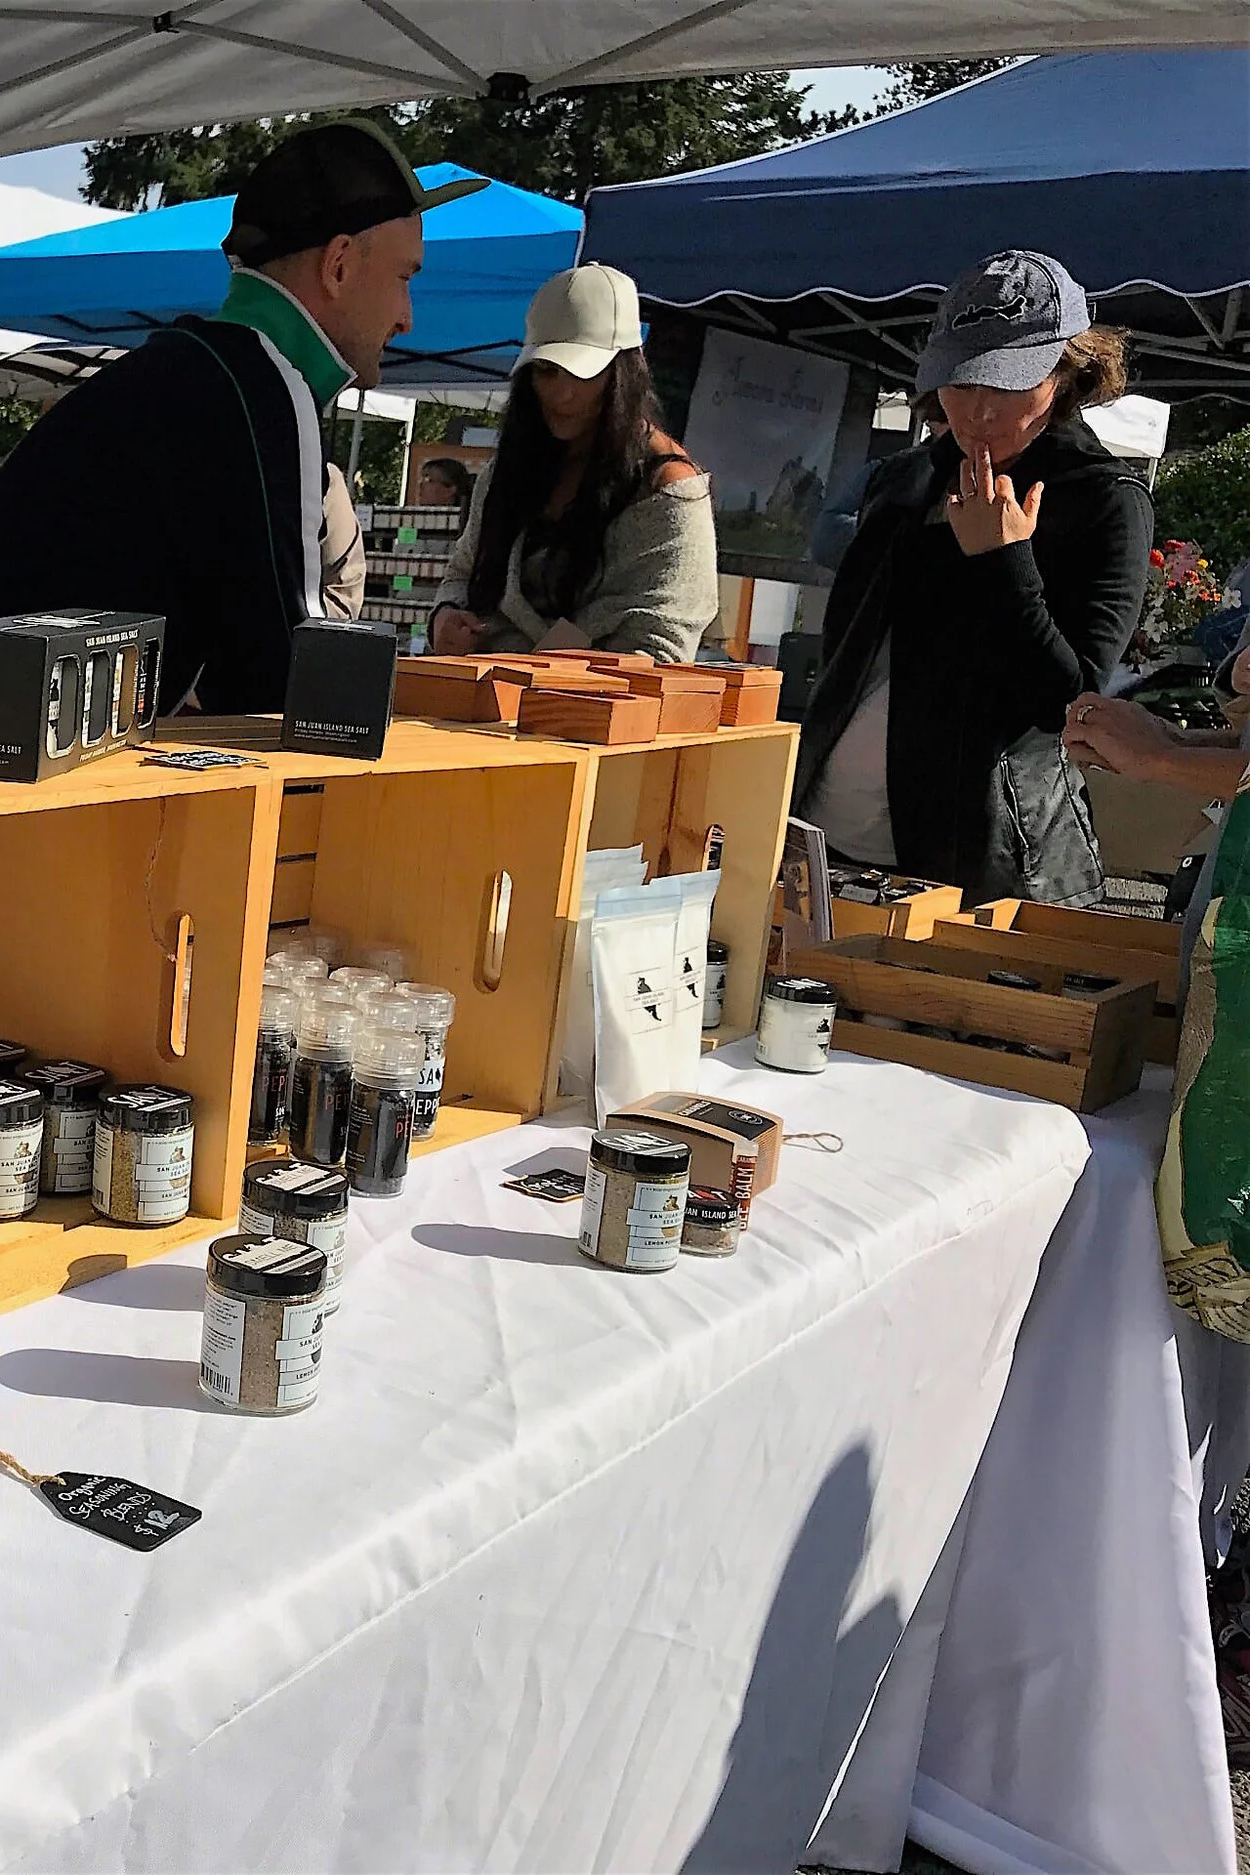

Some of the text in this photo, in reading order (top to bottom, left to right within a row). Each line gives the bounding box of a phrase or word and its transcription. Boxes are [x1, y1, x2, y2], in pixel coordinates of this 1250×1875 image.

[323, 723, 343, 732] ISLAND
[6, 745, 22, 754] SALT
[735, 1167, 755, 1199] BALM
[702, 1210, 727, 1220] ISLAND
[299, 1340, 312, 1348] SAN
